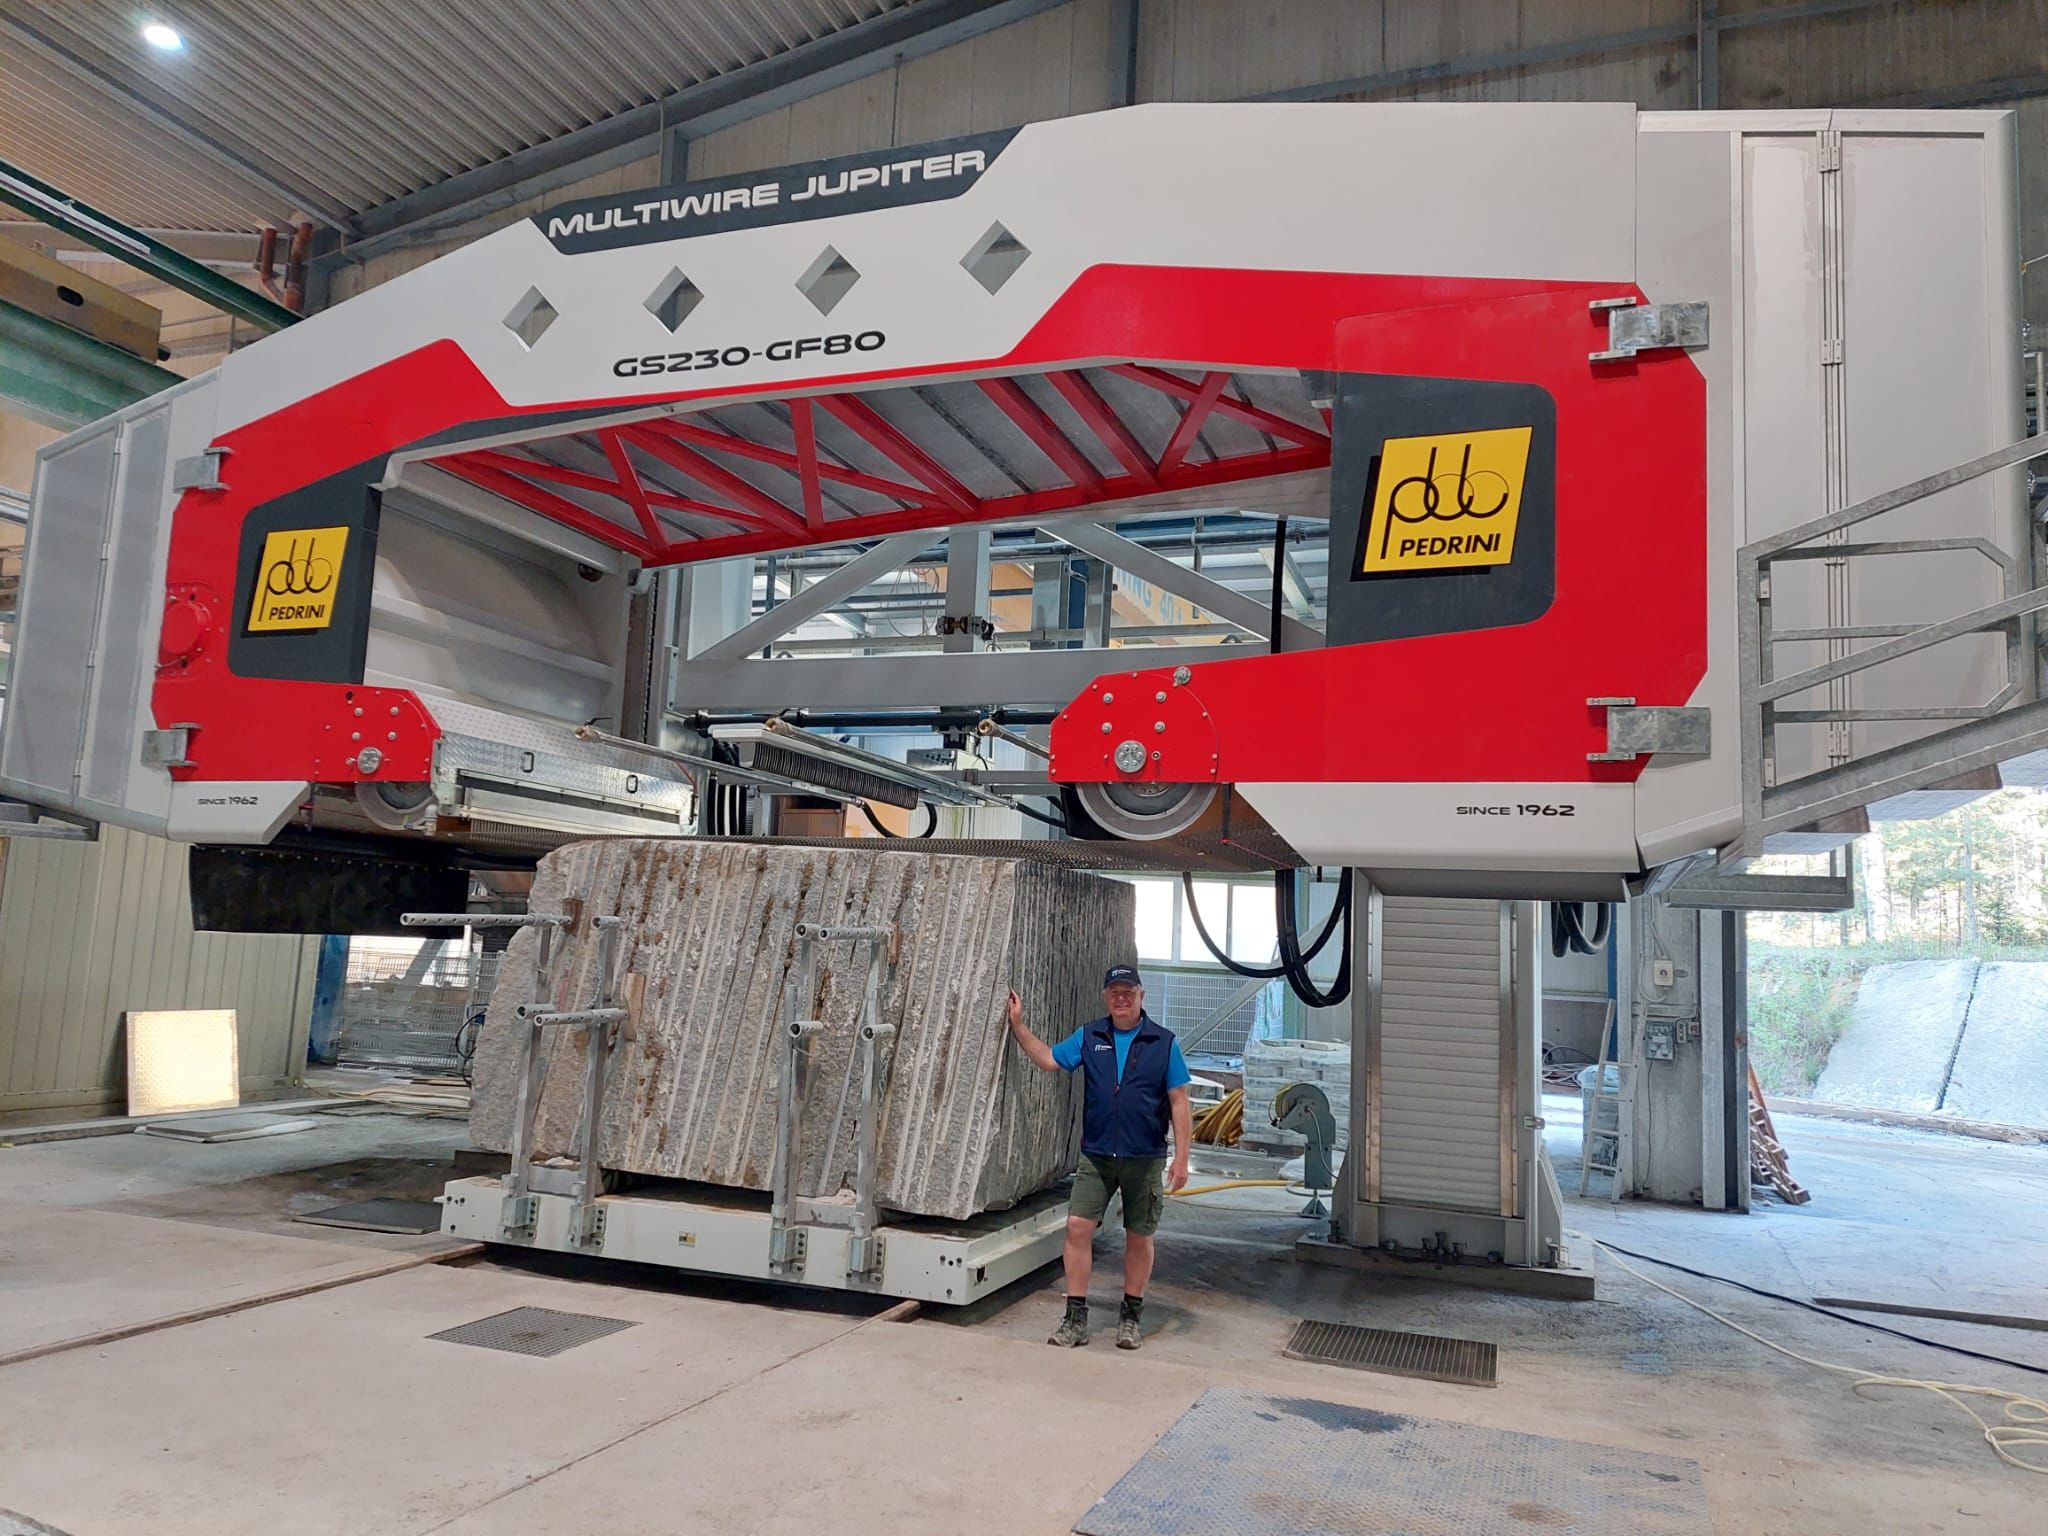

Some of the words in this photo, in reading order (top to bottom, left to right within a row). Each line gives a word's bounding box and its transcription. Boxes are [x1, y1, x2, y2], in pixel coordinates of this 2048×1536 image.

[548, 182, 780, 238] MULTIWIRE
[790, 150, 986, 201] JUPITER
[612, 330, 886, 377] GS230-GF80
[1399, 532, 1502, 558] PEDRINI
[268, 603, 326, 621] PEDRINI
[228, 796, 259, 805] 1962
[1456, 806, 1512, 816] SINCE
[1516, 804, 1576, 817] 1962
